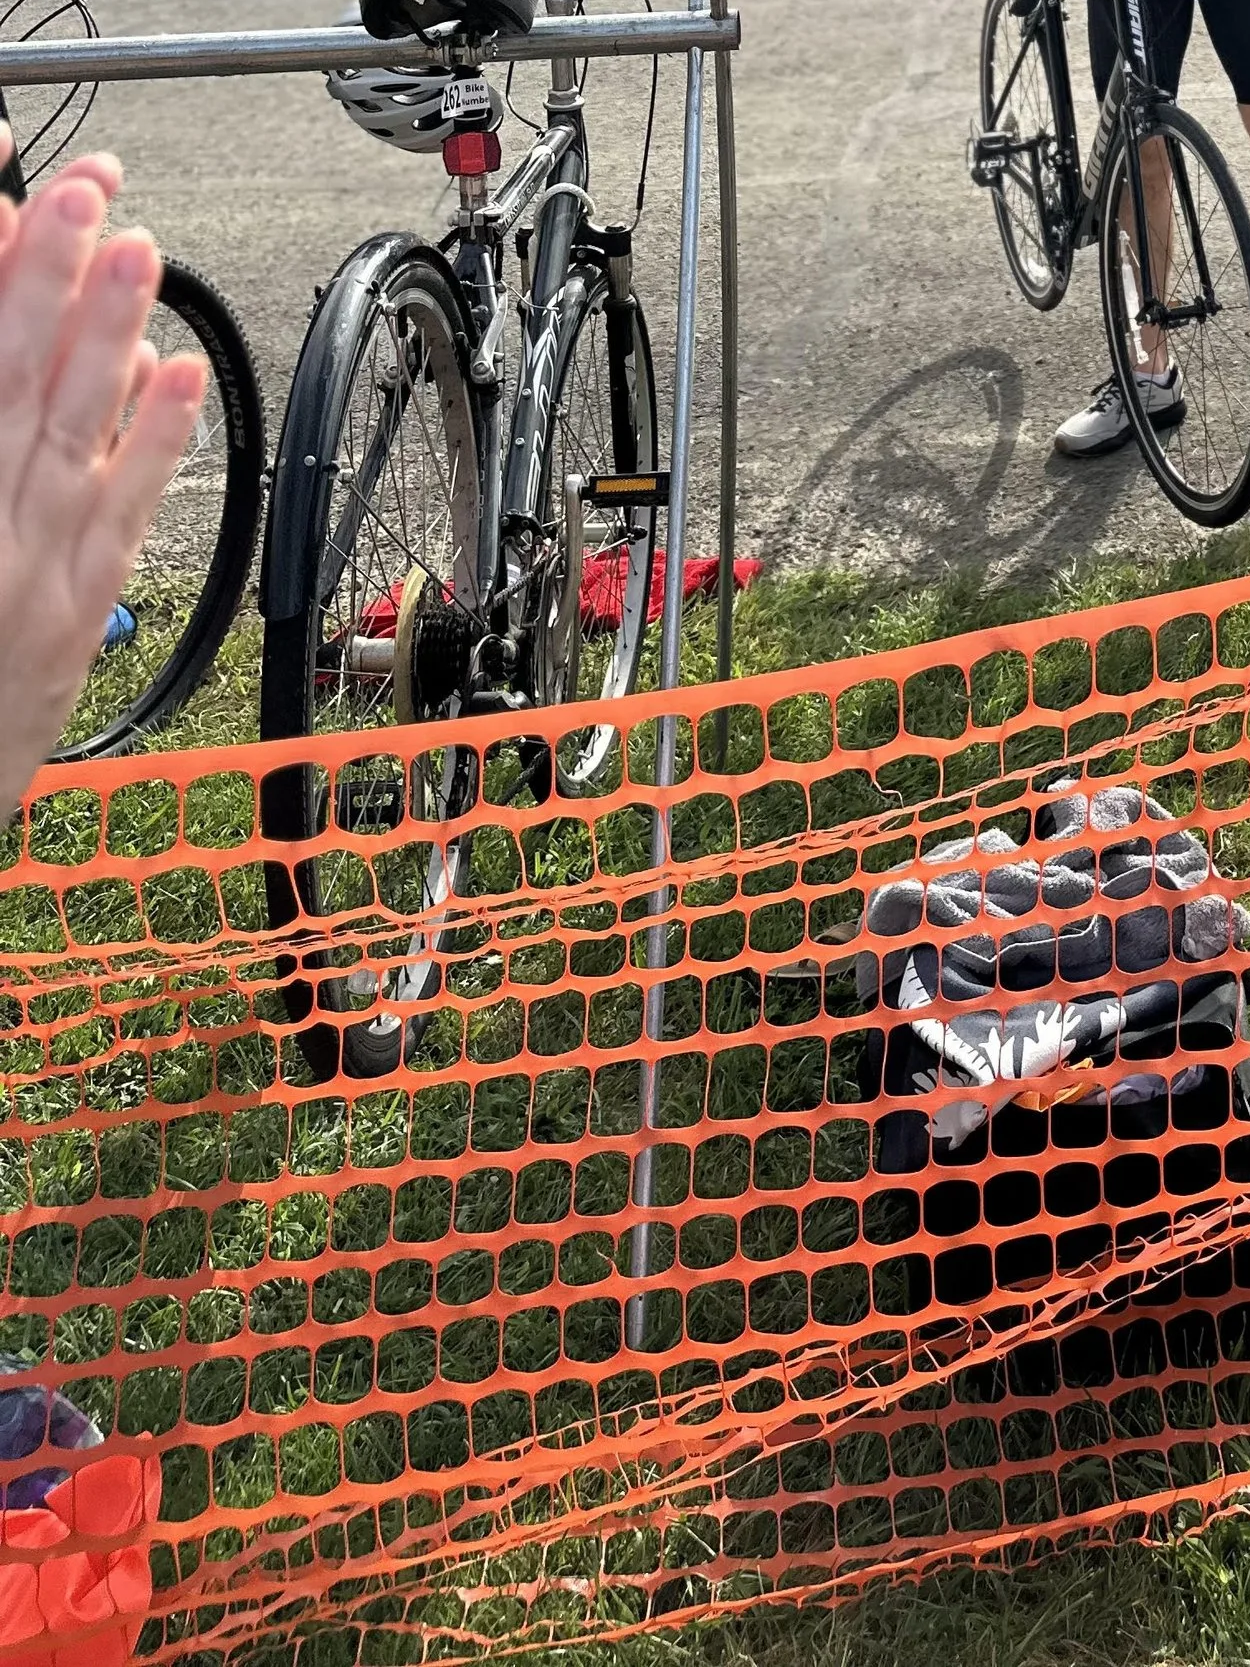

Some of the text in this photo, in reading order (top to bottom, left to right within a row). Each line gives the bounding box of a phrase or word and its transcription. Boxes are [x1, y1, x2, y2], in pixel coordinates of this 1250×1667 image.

[443, 84, 461, 112] 262
[462, 96, 490, 106] Numbe
[465, 84, 485, 92] Bike
[1082, 92, 1117, 200] GIANT
[179, 303, 246, 449] BONTRAGER
